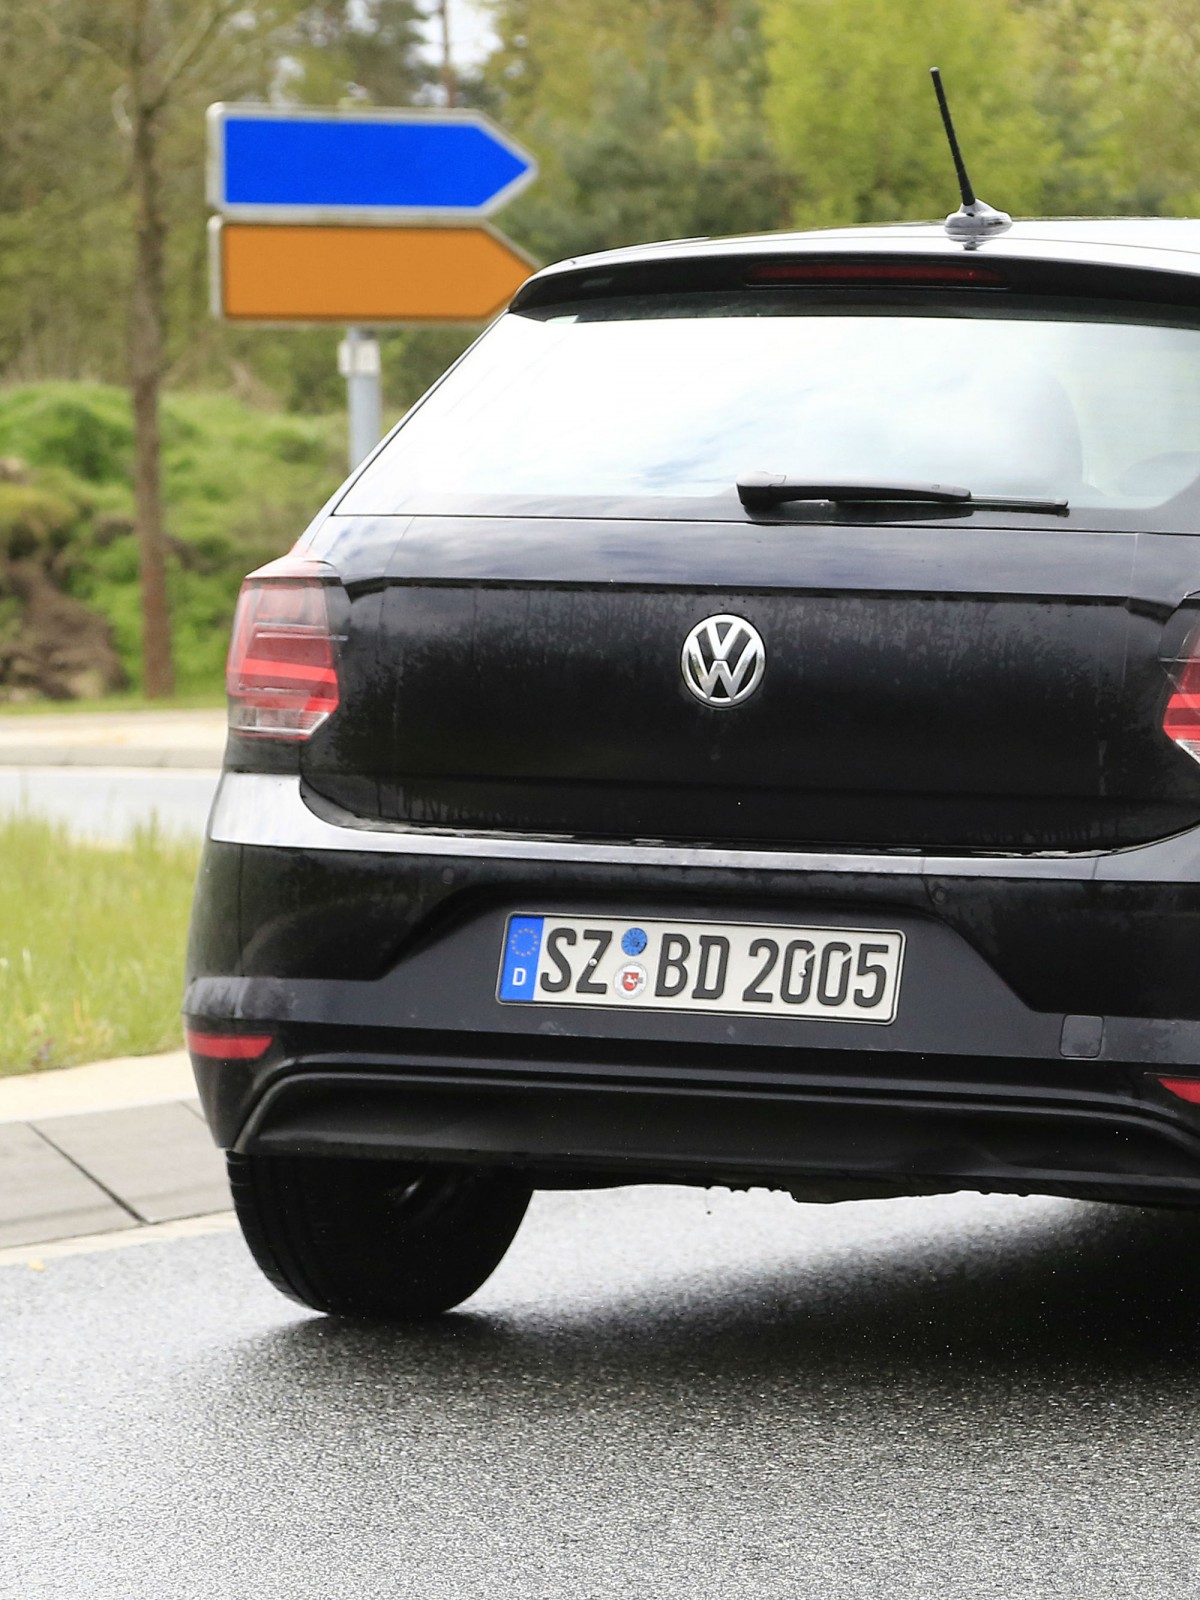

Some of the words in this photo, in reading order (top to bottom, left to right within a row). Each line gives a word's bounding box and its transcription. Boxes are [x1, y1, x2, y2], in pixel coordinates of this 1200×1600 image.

[681, 614, 766, 708] VW
[512, 967, 526, 986] D
[539, 927, 613, 995] SZ
[654, 933, 730, 1000] BD
[742, 938, 889, 1008] 2005
